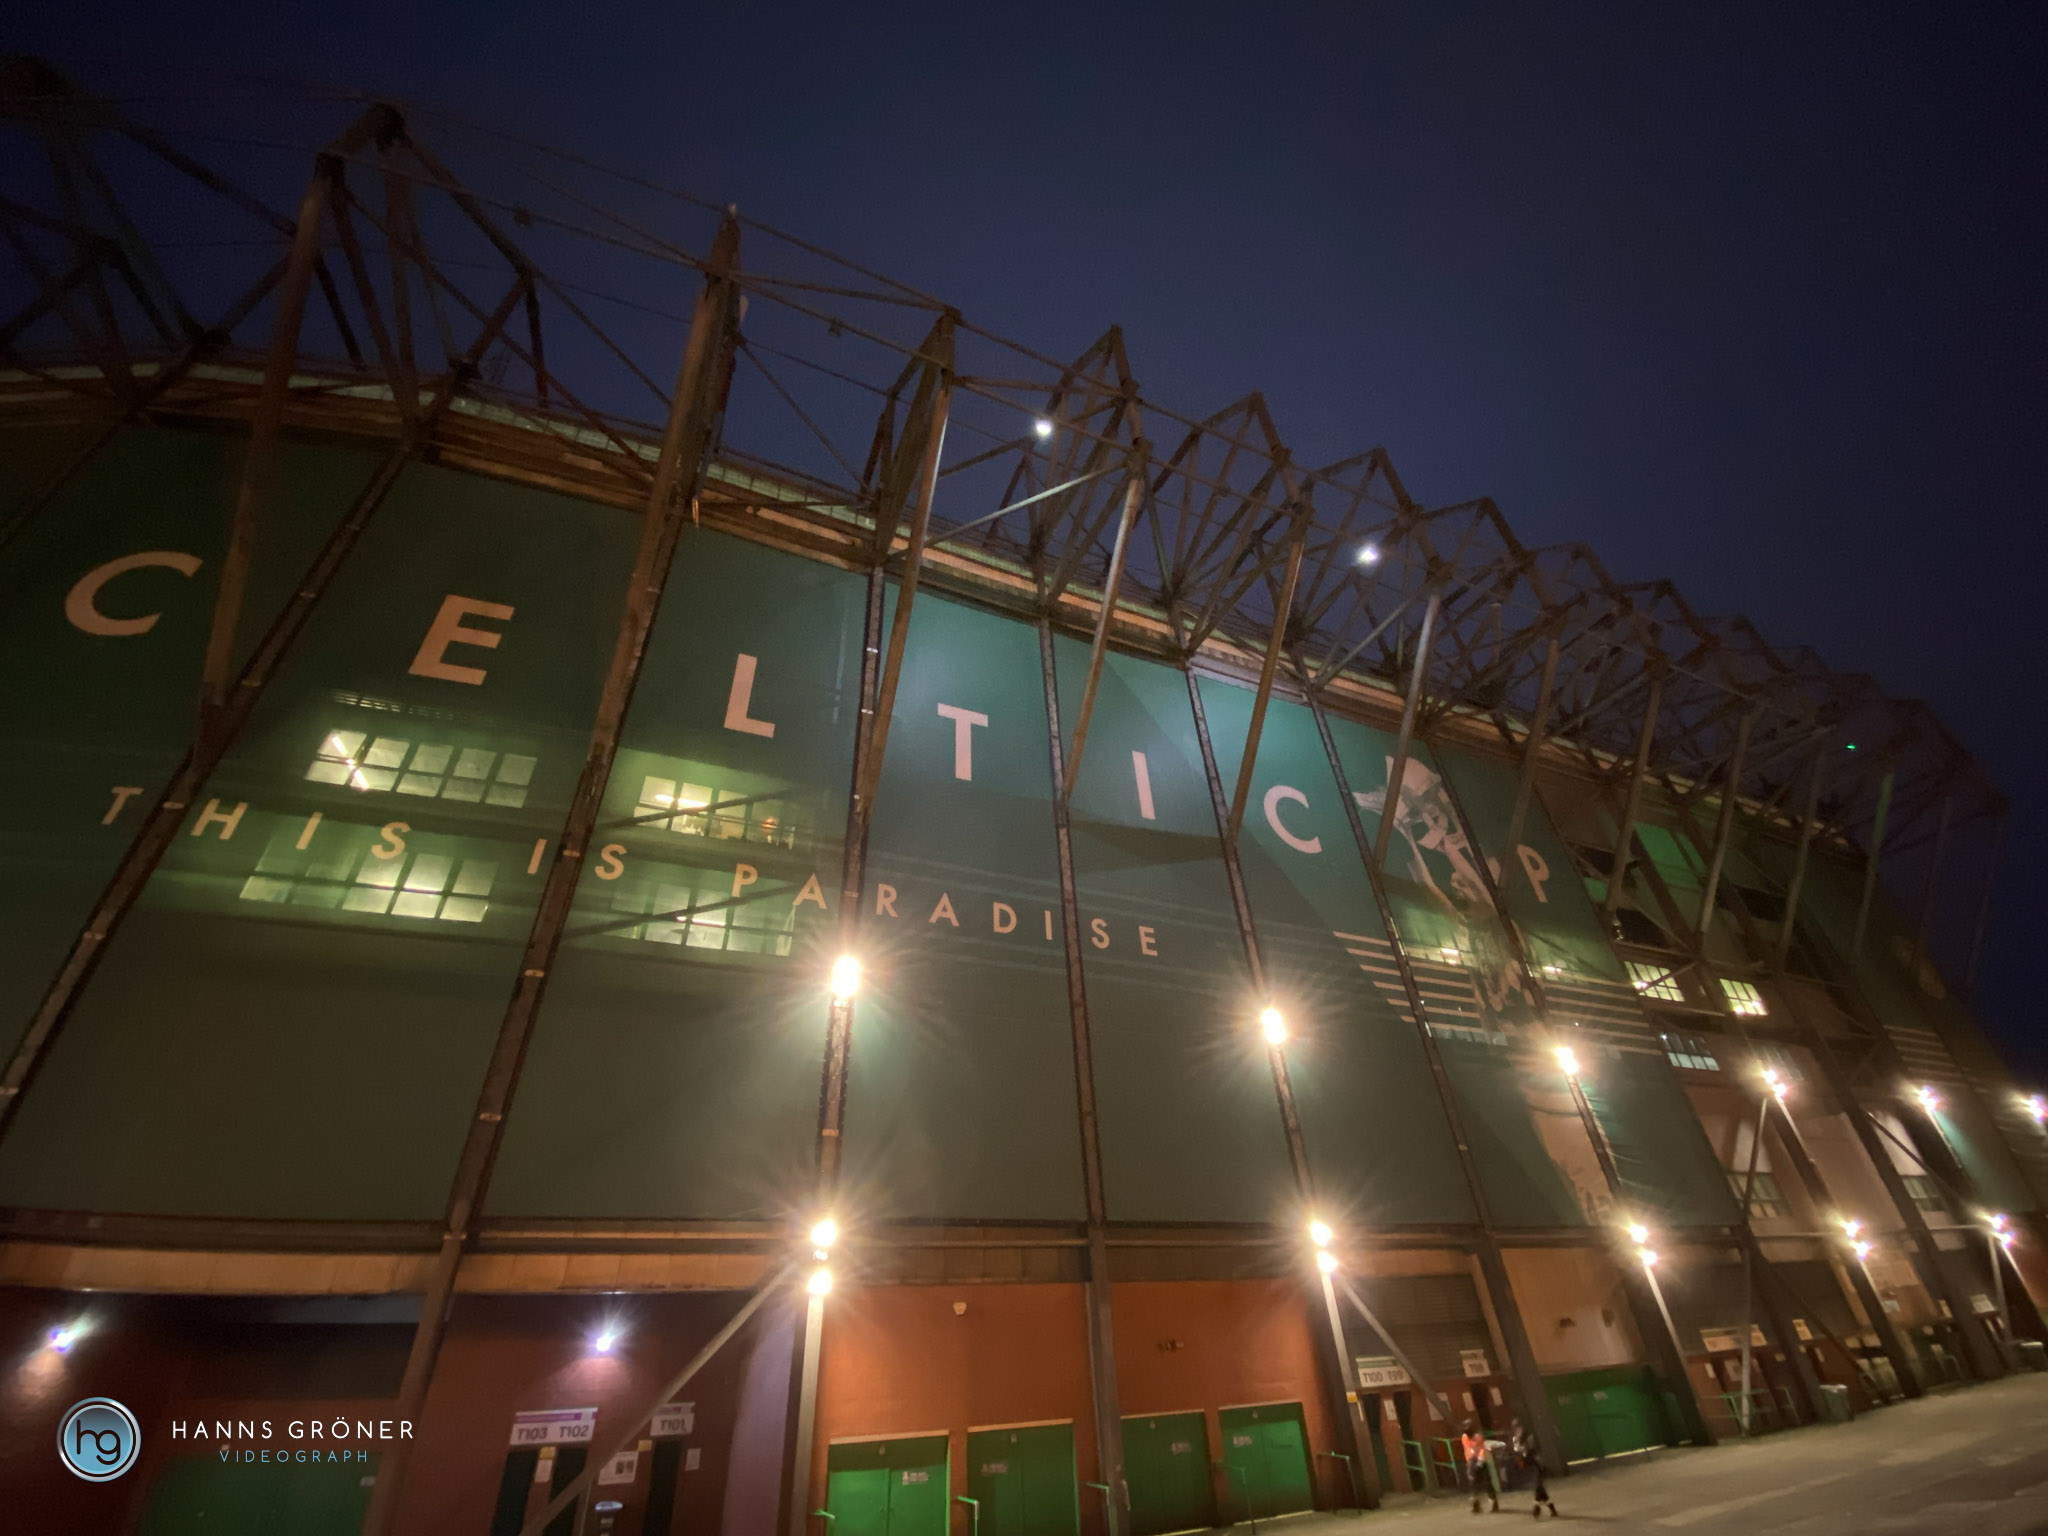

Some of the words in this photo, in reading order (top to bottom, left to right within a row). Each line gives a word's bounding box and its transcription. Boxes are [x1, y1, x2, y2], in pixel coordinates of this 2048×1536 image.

[64, 550, 1323, 855] CELTIC
[101, 786, 411, 860] THIS
[527, 838, 627, 881] IS
[731, 864, 1159, 957] PARADISE
[517, 1427, 548, 1441] T103
[559, 1425, 590, 1438] T102
